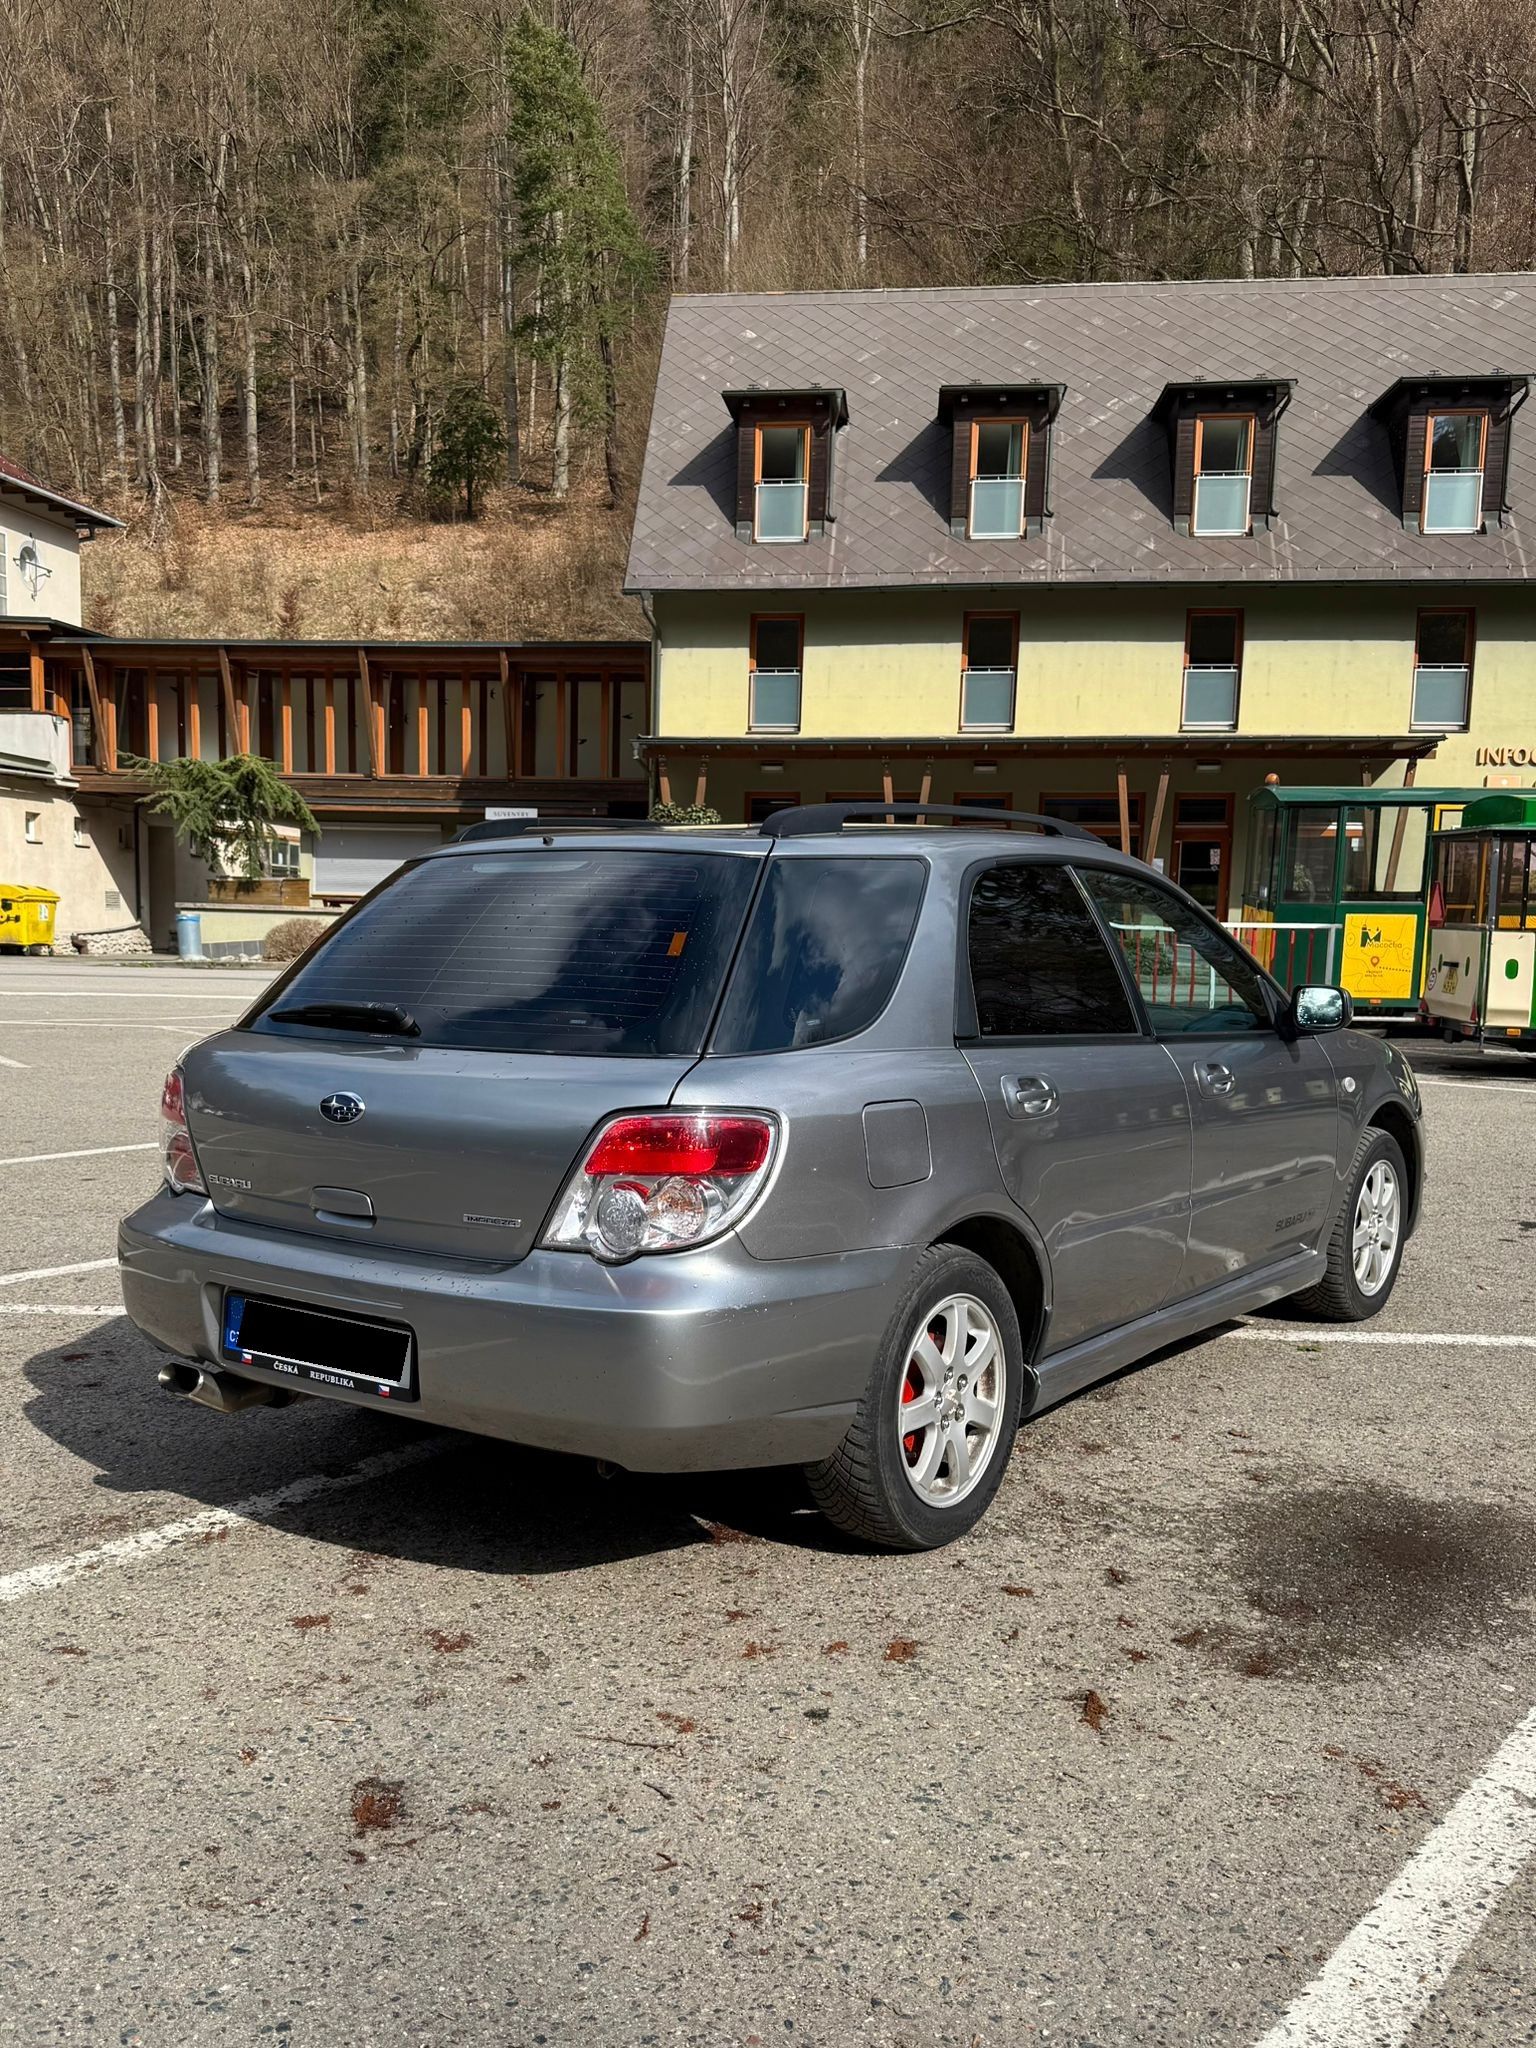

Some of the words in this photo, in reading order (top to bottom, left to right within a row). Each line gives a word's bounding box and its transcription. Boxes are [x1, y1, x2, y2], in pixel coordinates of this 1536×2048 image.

[209, 1174, 252, 1189] SUBARU
[273, 1360, 299, 1375] ČESKÁ
[310, 1370, 355, 1388] REPUBLIKA
